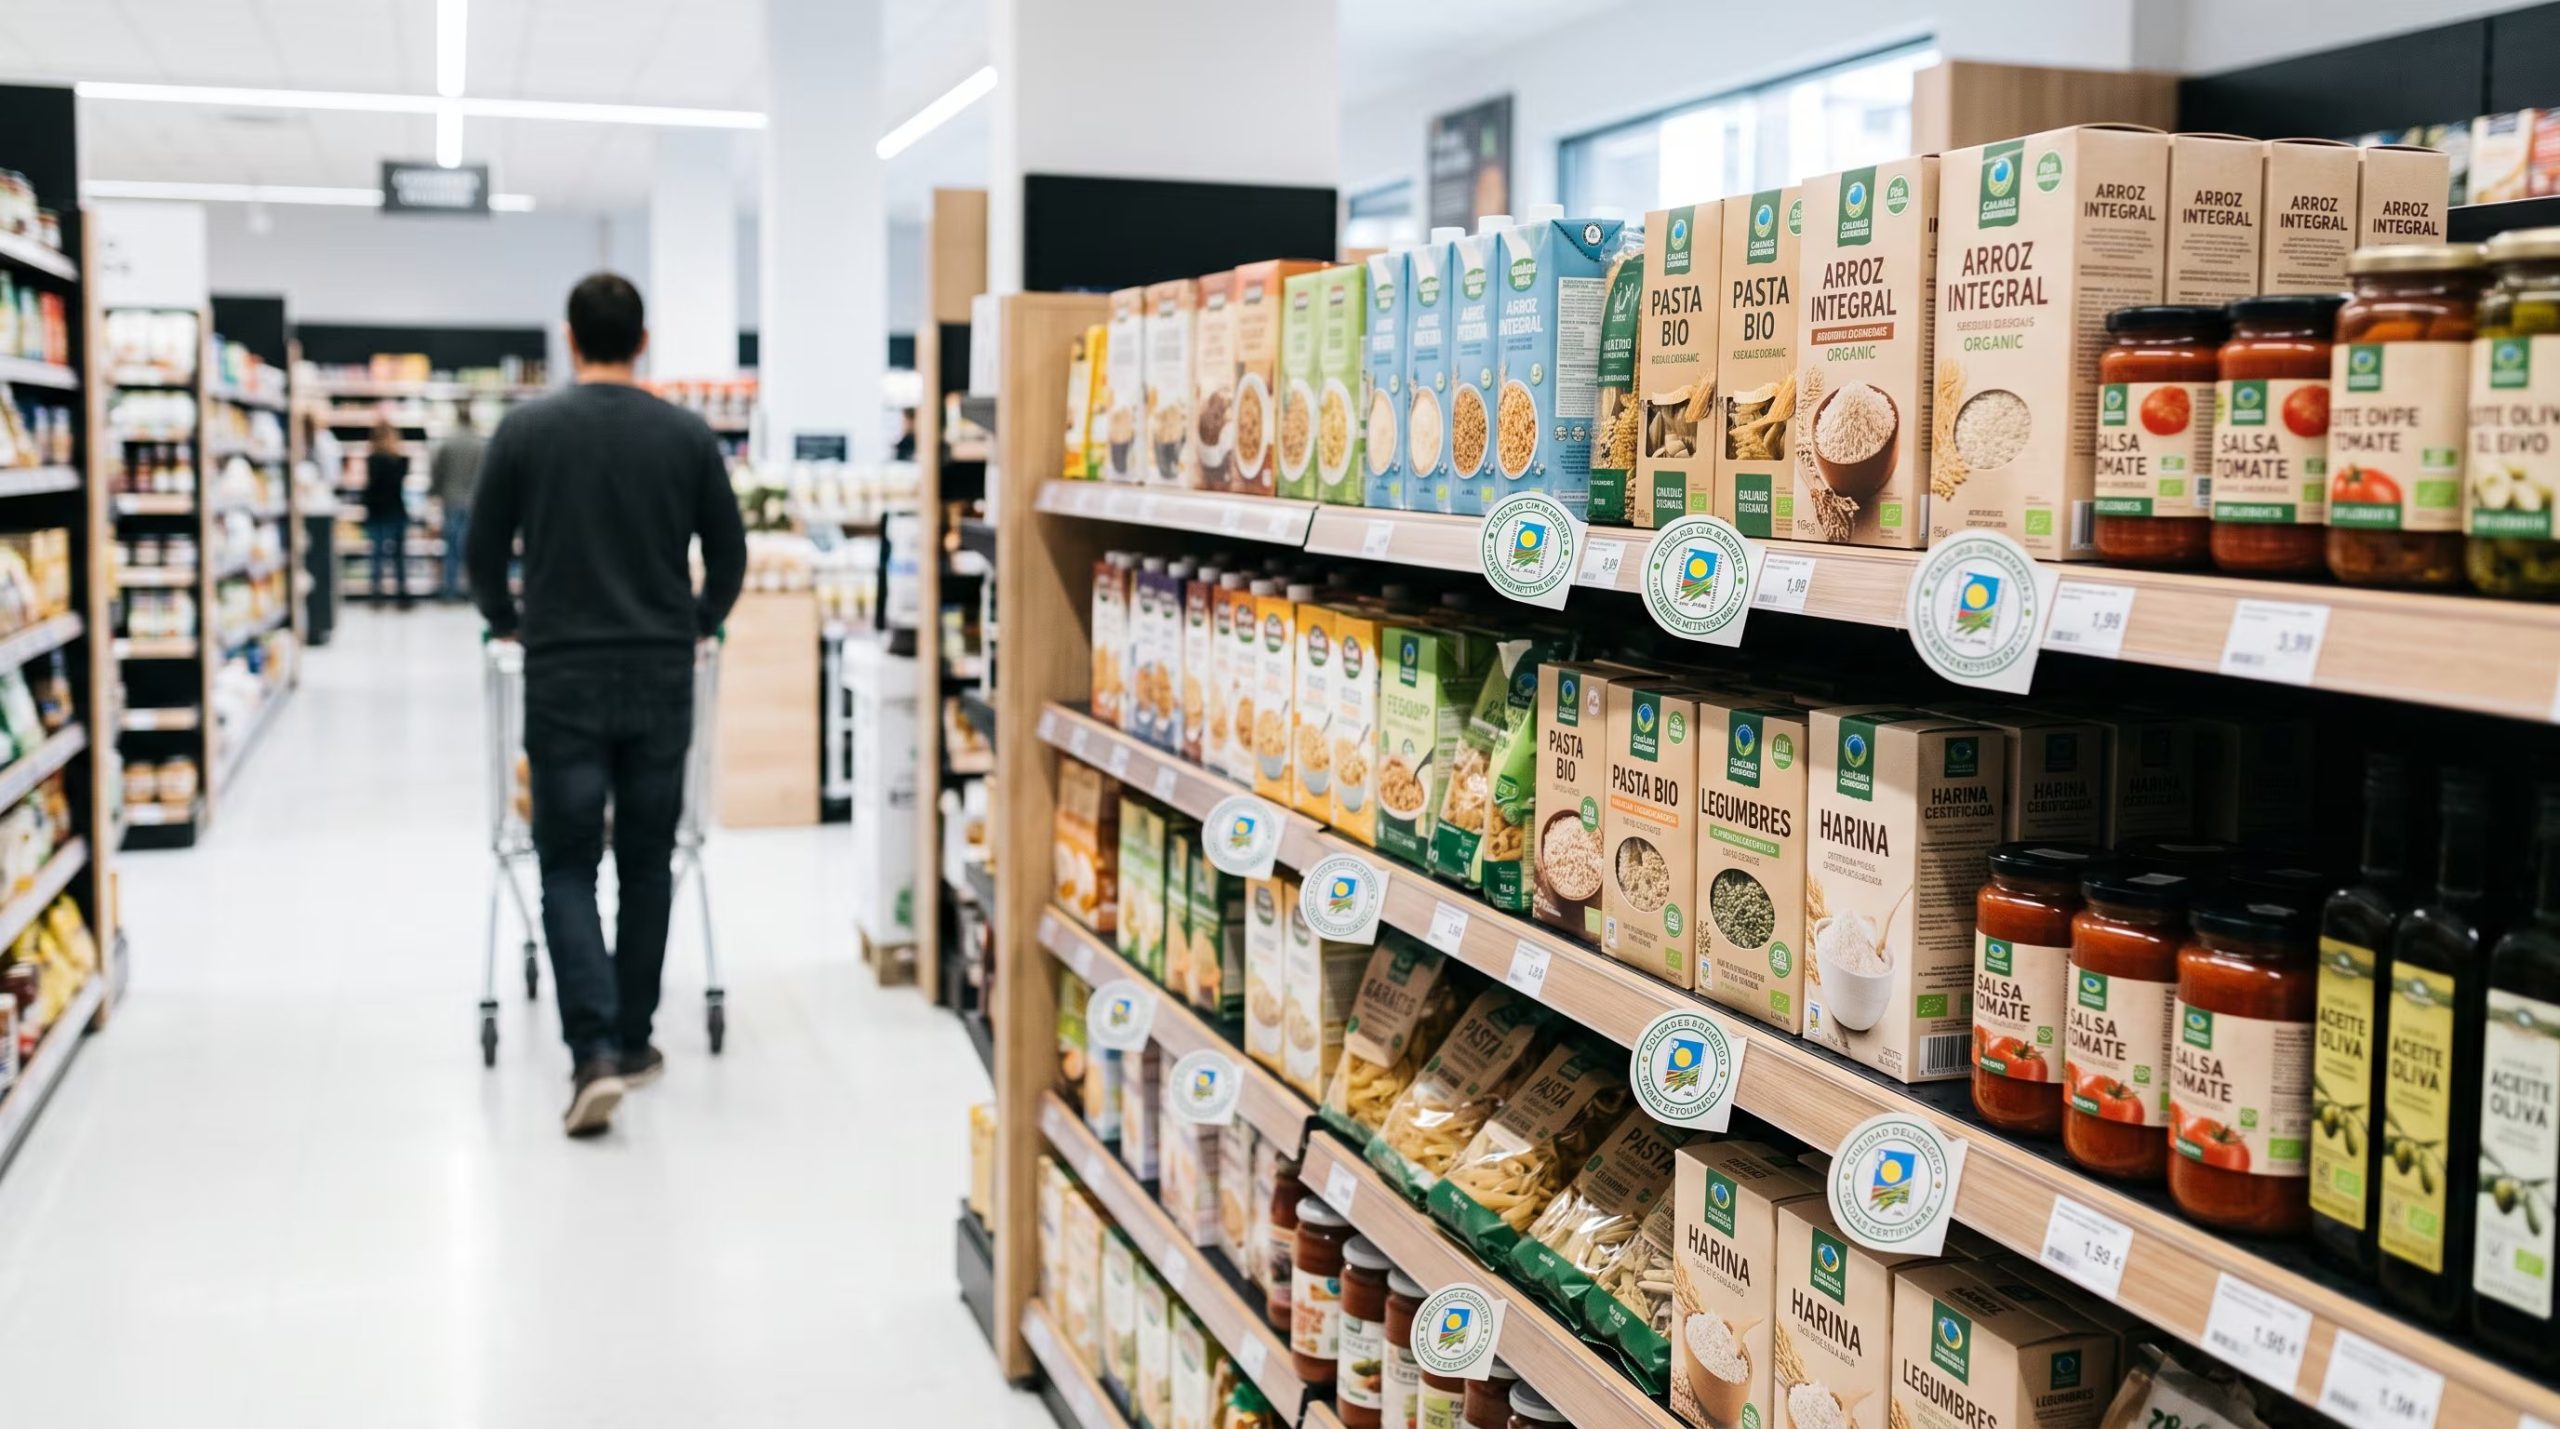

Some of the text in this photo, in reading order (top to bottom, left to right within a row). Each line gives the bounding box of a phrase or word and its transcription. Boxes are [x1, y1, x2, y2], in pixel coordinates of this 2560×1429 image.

[2095, 183, 2146, 201] ARROZ
[2194, 190, 2243, 208] ARROZ
[2290, 195, 2338, 212] ARROZ
[2382, 200, 2429, 217] ARROZ
[2083, 201, 2156, 221] INTEGRAL
[2182, 208, 2253, 227] INTEGRAL
[2280, 213, 2348, 232] INTEGRAL
[2373, 218, 2439, 236] INTEGRAL
[1822, 256, 1885, 290] ARROZ
[1961, 241, 2034, 277] ARROZ
[1651, 285, 1702, 317] PASTA
[1732, 275, 1790, 309] PASTA
[1811, 289, 1897, 323] INTEGRAL
[1947, 276, 2048, 312] INTEGRAL
[1661, 318, 1690, 347] BIO
[1744, 311, 1775, 341] BIO
[1826, 345, 1877, 362] ORGANIC
[1964, 334, 2024, 352] ORGANIC
[2220, 433, 2280, 454] SALSA
[2098, 456, 2147, 476] OMATE
[2216, 458, 2290, 479] TOMATE
[1549, 729, 1584, 759] PASTA
[1556, 759, 1576, 783] BIO
[1612, 764, 1679, 807] PASTA BIO
[1931, 786, 1988, 805] HARINA
[1701, 787, 1792, 838] LEGUMBRES
[1819, 808, 1890, 858] HARINA
[1977, 973, 2023, 1002] SALSA
[1974, 989, 2031, 1023] TOMATE
[2069, 1007, 2118, 1038] SALSA
[2320, 1006, 2366, 1038] ACEITE
[1458, 1018, 1503, 1060] PASTA
[2068, 1027, 2127, 1062] TOMATE
[2320, 1028, 2364, 1061] OLIVA
[2393, 1036, 2443, 1070] ACEITE
[2174, 1045, 2225, 1080] SALSA
[2392, 1058, 2440, 1094] OLIVA
[1530, 1076, 1577, 1110] PASTA
[2171, 1063, 2233, 1104] TOMATE
[2491, 1070, 2552, 1104] ACEITE
[2490, 1092, 2549, 1130] OLIVA
[1620, 1127, 1675, 1176] PASTA
[1688, 1223, 1751, 1288] HARINA
[1791, 1287, 1863, 1358] HARINA
[1903, 1357, 1998, 1429] LEGUMBRES
